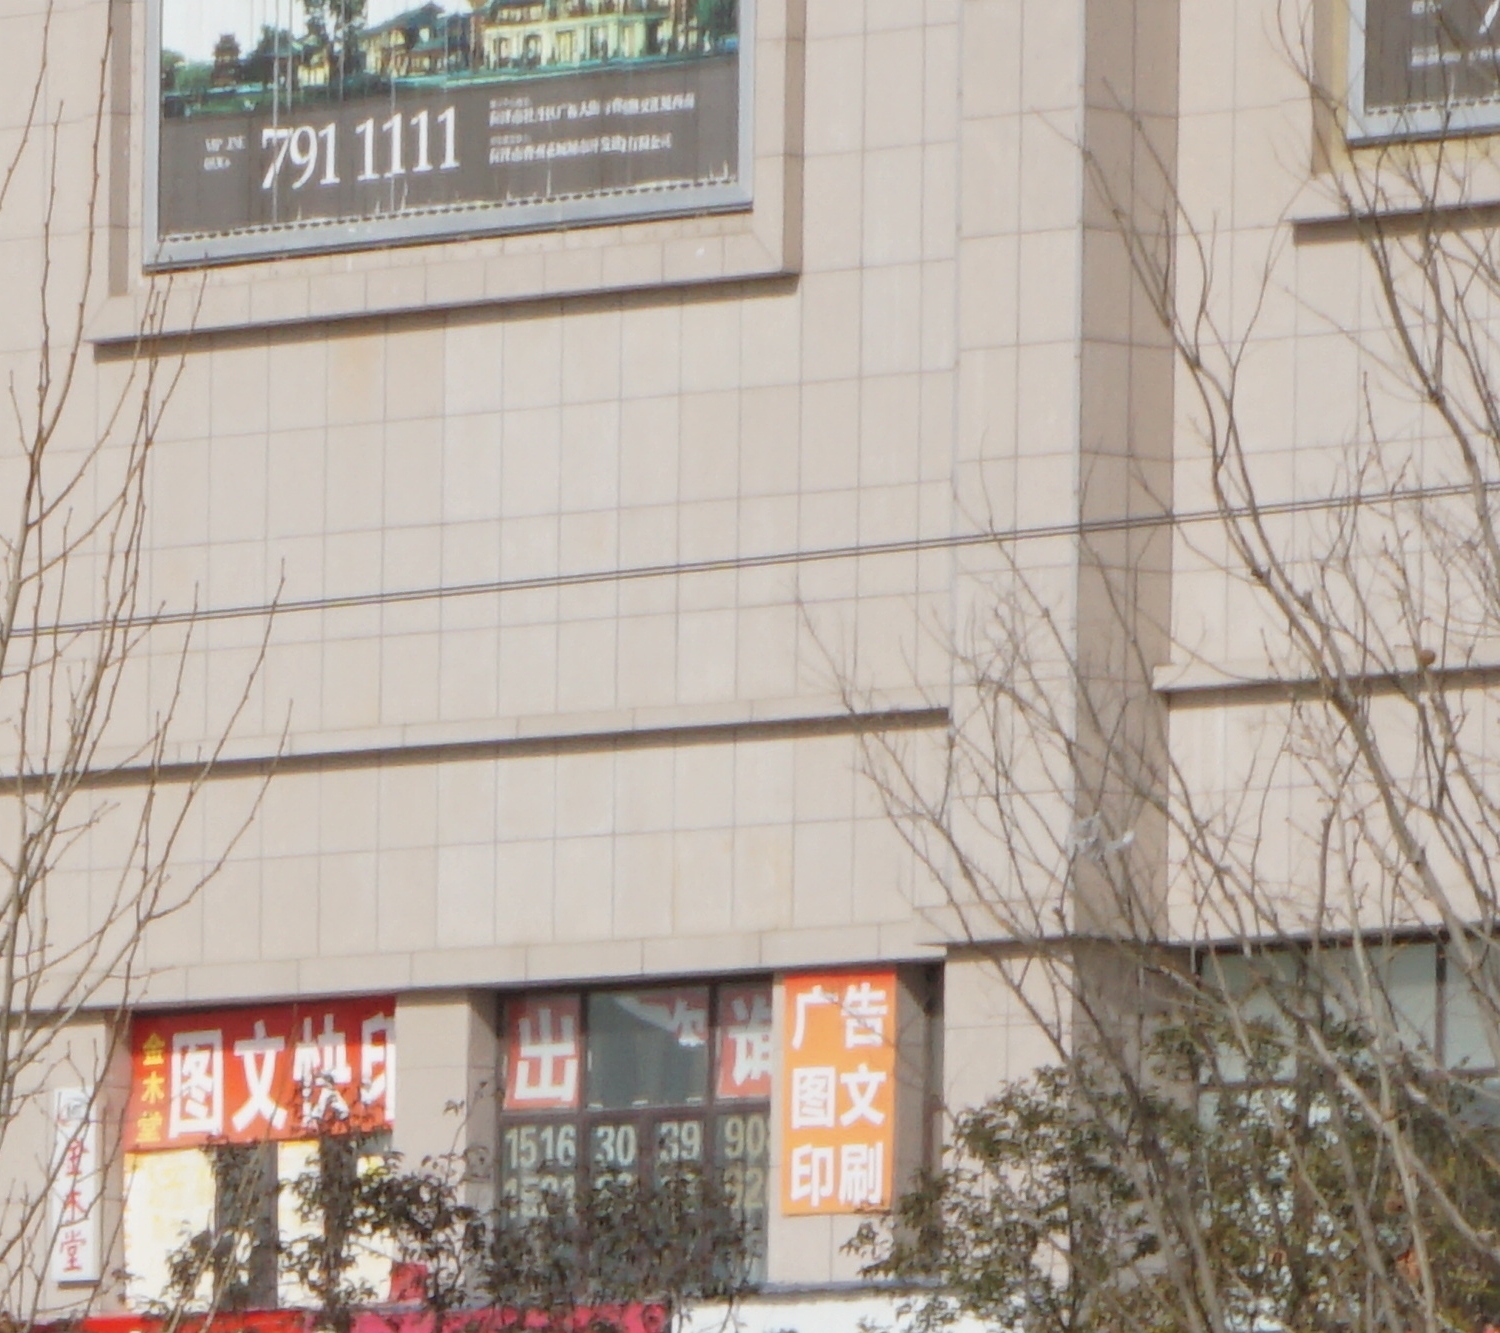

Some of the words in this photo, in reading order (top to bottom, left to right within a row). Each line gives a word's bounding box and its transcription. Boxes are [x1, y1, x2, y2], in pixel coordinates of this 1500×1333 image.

[792, 982, 888, 1050] 广告
[791, 1062, 888, 1130] 图文
[790, 1142, 884, 1208] 印刷
